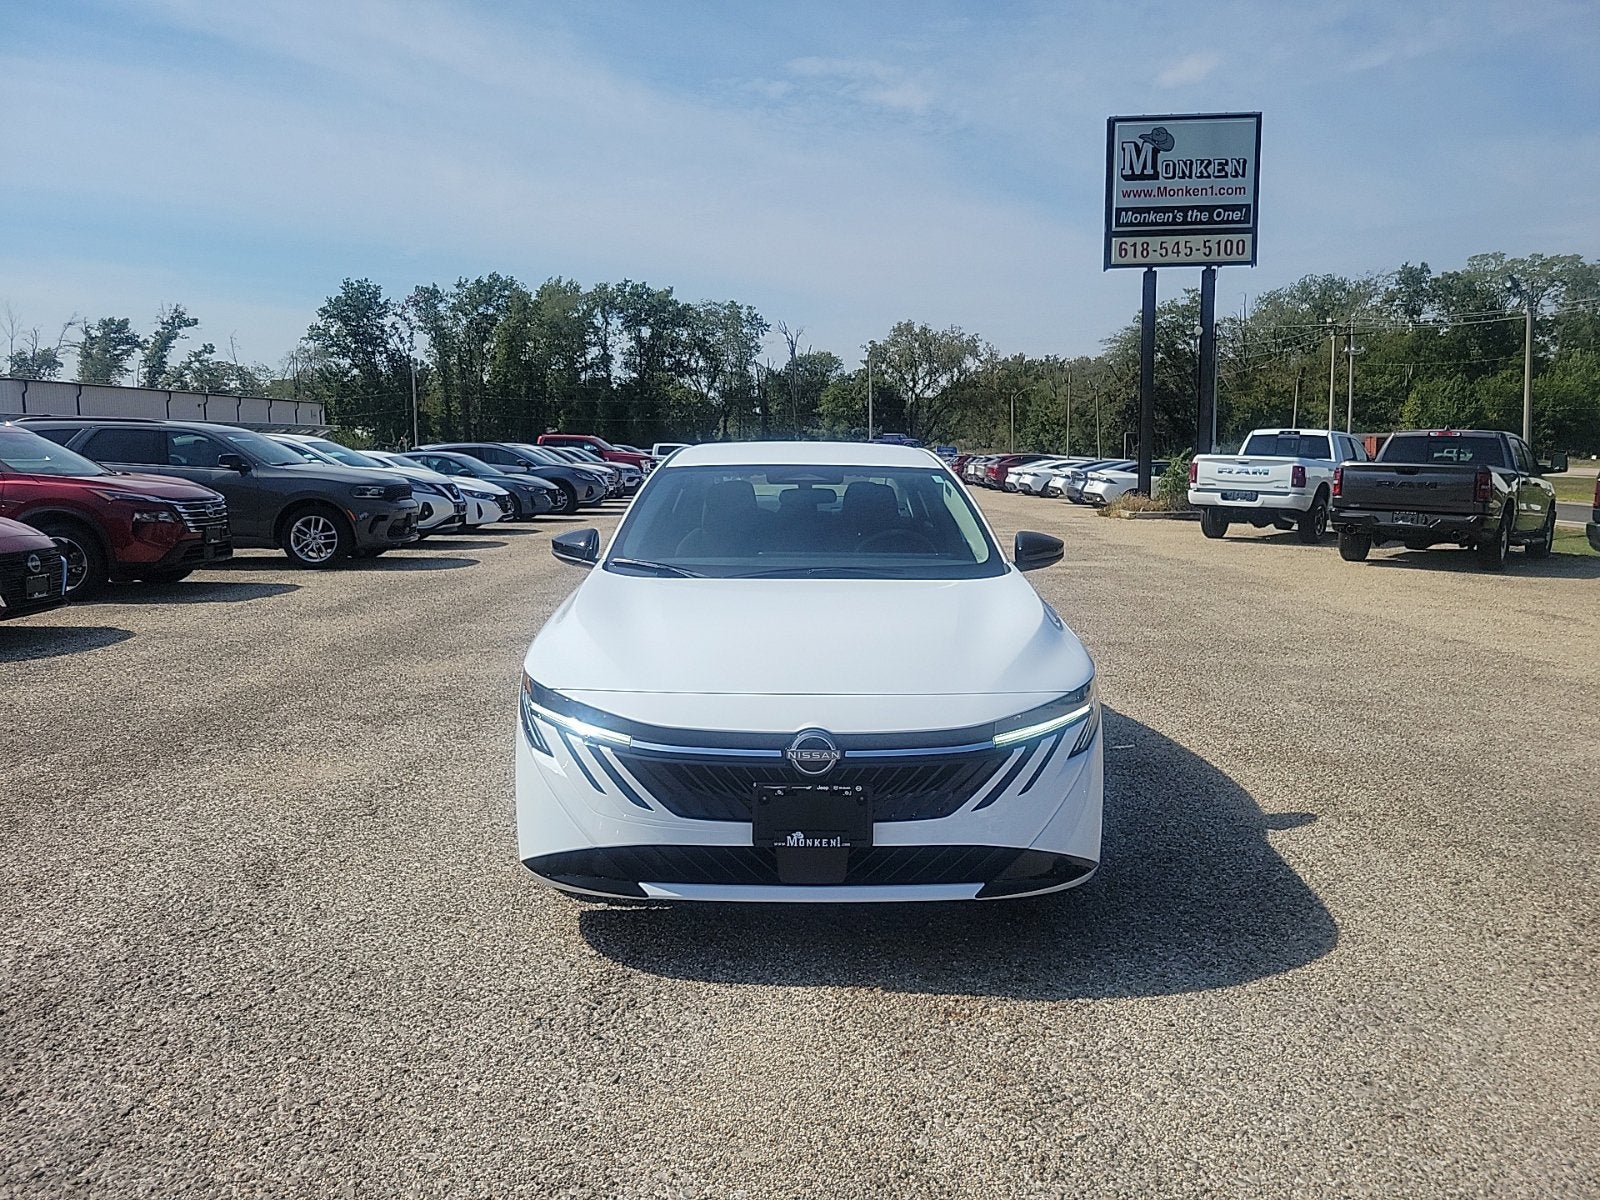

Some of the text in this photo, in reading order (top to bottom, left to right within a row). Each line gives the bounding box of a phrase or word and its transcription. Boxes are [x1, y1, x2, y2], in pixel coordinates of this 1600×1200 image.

[1122, 185, 1246, 198] www.Monken1.com
[1120, 208, 1246, 223] Monken's the One!
[1118, 239, 1246, 259] 618-545-5100
[1217, 467, 1270, 476] RAM
[787, 751, 840, 759] NISSAN
